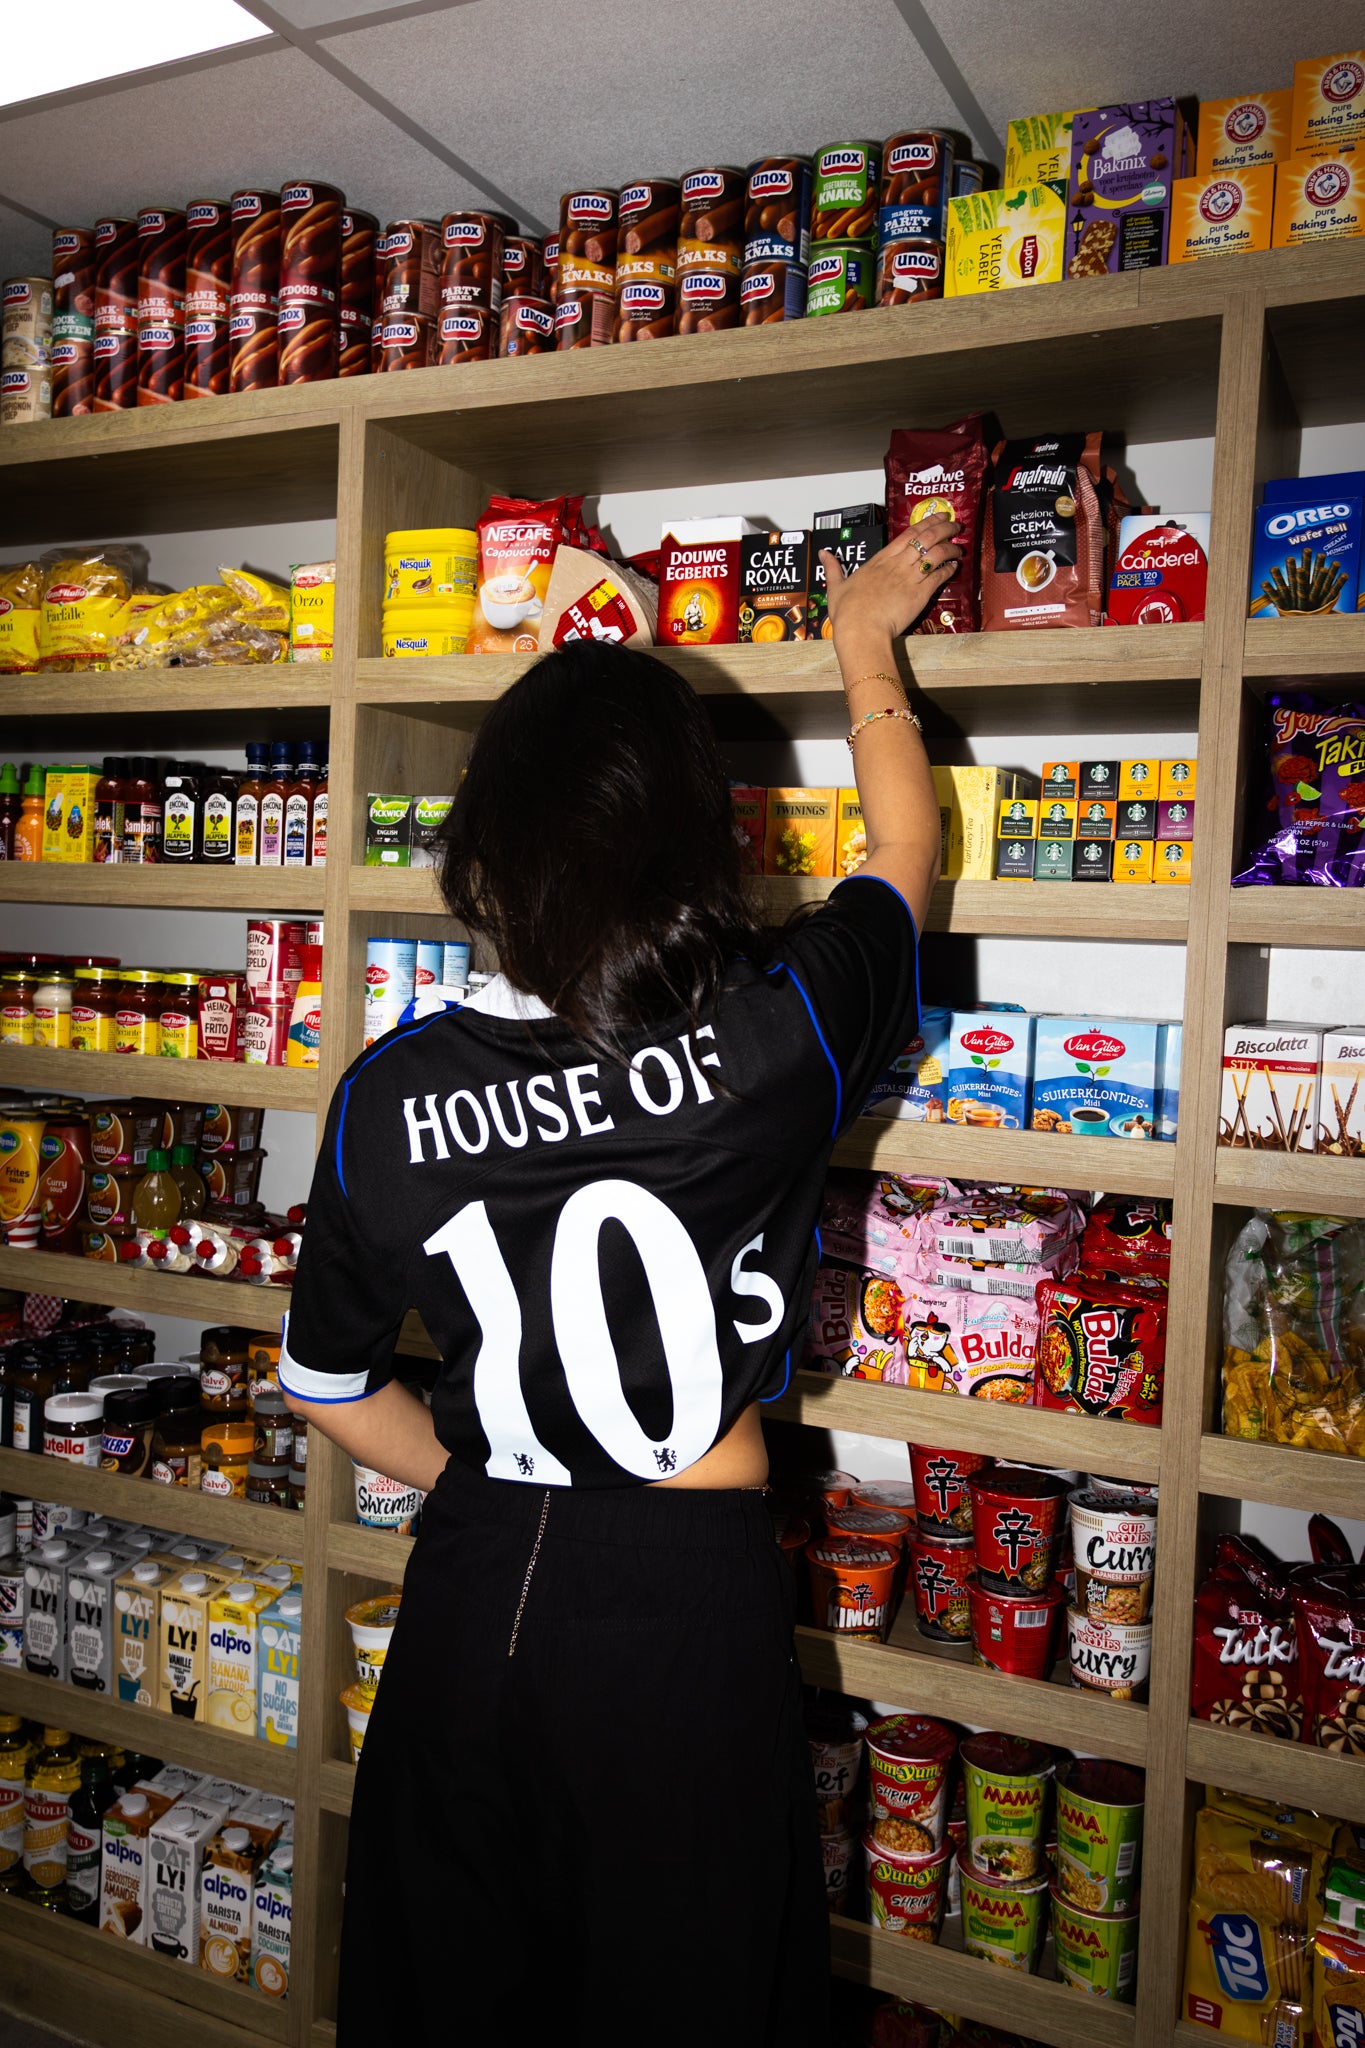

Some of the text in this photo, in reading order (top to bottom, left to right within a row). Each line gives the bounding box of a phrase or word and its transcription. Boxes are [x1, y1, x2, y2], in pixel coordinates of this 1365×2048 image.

[1332, 103, 1352, 115] pure
[1308, 114, 1343, 128] Baking
[893, 145, 933, 162] unox
[1235, 144, 1254, 155] pure
[823, 149, 862, 167] unox
[1212, 151, 1273, 167] Baking Soda
[1093, 156, 1147, 180] Bakmix
[685, 175, 719, 191] unox
[752, 172, 789, 188] unox
[819, 188, 862, 204] KNAKS
[1051, 184, 1063, 195] NEW
[572, 197, 608, 211] unox
[891, 208, 923, 218] magere
[1315, 207, 1336, 219] pure
[446, 223, 479, 238] unox
[884, 215, 931, 233] PARTY
[1210, 223, 1230, 235] pure
[1290, 213, 1358, 232] Baking Soda
[891, 226, 921, 236] KNAKS
[1186, 230, 1250, 248] Baking Soda
[677, 250, 727, 268] KNAKS
[744, 243, 794, 260] KNAKS
[1024, 239, 1035, 275] Lipton
[896, 253, 938, 268] unox
[978, 243, 990, 285] LABEL
[989, 233, 1003, 290] YELLOW
[561, 270, 613, 286] KNAKS
[685, 276, 720, 291] unox
[442, 286, 481, 299] PARTY
[446, 294, 473, 302] KNAKS
[625, 286, 661, 300] unox
[443, 318, 479, 330] unox
[520, 307, 552, 328] unox
[141, 329, 170, 340] unox
[384, 325, 412, 338] unox
[1002, 464, 1066, 491] Segafredo
[905, 481, 965, 496] EGBERTS
[1010, 510, 1054, 520] selezione
[1268, 504, 1350, 535] OREO
[1011, 519, 1055, 534] CREMA
[1288, 522, 1348, 545] Wafer Roll
[1032, 538, 1056, 546] CREMOSO
[1323, 533, 1347, 551] CREAMY
[485, 545, 551, 559] Cappuccino
[750, 546, 794, 568] CAFÉ
[1121, 549, 1198, 570] Canderel
[400, 558, 431, 570] Nesquik
[666, 564, 728, 581] EGBERTS
[745, 567, 801, 586] ROYAL
[1143, 571, 1158, 580] 120
[756, 584, 794, 592] SWITZERLAND
[1117, 579, 1141, 587] PACK
[293, 593, 324, 607] Orzo
[46, 606, 85, 622] Farfalle
[396, 638, 428, 650] Nesquik
[520, 640, 533, 650] 25
[238, 803, 256, 811] ENCONA
[263, 802, 281, 811] ENCONA
[287, 803, 306, 812] ENCONA
[370, 809, 406, 818] PICKWICK
[776, 805, 826, 815] TWININGS
[125, 818, 154, 834] Sambal
[1305, 820, 1330, 828] PEPPER
[207, 1002, 229, 1012] HEINZ
[205, 1023, 229, 1035] FRITO
[963, 1034, 1012, 1051] Van Gilse
[1067, 1038, 1121, 1058] Van Gilse
[1234, 1037, 1309, 1055] Biscolata
[1230, 1060, 1258, 1071] STIX
[403, 1024, 721, 1163] HOUSE OF
[952, 1083, 1019, 1098] SUIKERKLONTJES
[978, 1090, 991, 1098] Mini
[1042, 1088, 1145, 1109] SUIKERKLONTJES
[1084, 1099, 1100, 1107] Midi
[5, 1166, 30, 1178] Frites
[46, 1177, 68, 1189] Curry
[918, 1297, 947, 1308] Samyang
[422, 1179, 723, 1488] 10
[1081, 1310, 1119, 1405] Buldak
[968, 1363, 1005, 1377] HOT Chicken
[201, 1376, 225, 1387] Calvé
[202, 1478, 228, 1490] Calvé
[925, 1455, 967, 1514] 辛
[1118, 1522, 1145, 1533] CUP
[993, 1506, 1043, 1571] 辛
[1106, 1531, 1151, 1544] NOODLES
[1094, 1570, 1122, 1581] JAPANESE
[916, 1555, 956, 1614] 辛
[31, 1589, 57, 1614] LY!
[75, 1601, 102, 1628] LY!
[30, 1619, 54, 1634] BARISTA
[121, 1614, 149, 1640] LY!
[30, 1630, 53, 1645] EDITION
[74, 1631, 99, 1648] BARISTA
[168, 1625, 197, 1652] LY!
[210, 1629, 251, 1654] alpro
[1077, 1631, 1121, 1651] NOODLES
[75, 1644, 98, 1658] EDITION
[125, 1641, 142, 1659] BIO
[1069, 1632, 1137, 1680] Curry
[169, 1653, 192, 1669] VANILLE
[267, 1648, 297, 1677] LY!
[211, 1661, 250, 1683] BANANA
[210, 1676, 246, 1692] FLAVOUR
[275, 1680, 288, 1696] NO
[1093, 1676, 1130, 1688] STYLE CURRY
[263, 1695, 297, 1716] SUGARS
[876, 1784, 921, 1804] SHRIMP
[983, 1786, 1041, 1807] MAMA
[987, 1817, 1013, 1827] VEGETABLE
[105, 1838, 142, 1866] alpro
[105, 1870, 140, 1891] GEROOSTERDE
[157, 1863, 186, 1892] LY!
[104, 1883, 138, 1902] AMANDEL
[204, 1874, 247, 1901] alpro
[967, 1888, 1024, 1918] MAMA
[207, 1902, 242, 1923] BARISTA
[209, 1919, 238, 1935] ALMOND
[258, 1921, 291, 1943] BARISTA
[258, 1936, 289, 1956] COCONUT
[1219, 1921, 1263, 1993] TUC
[1195, 2001, 1215, 2021] LU
